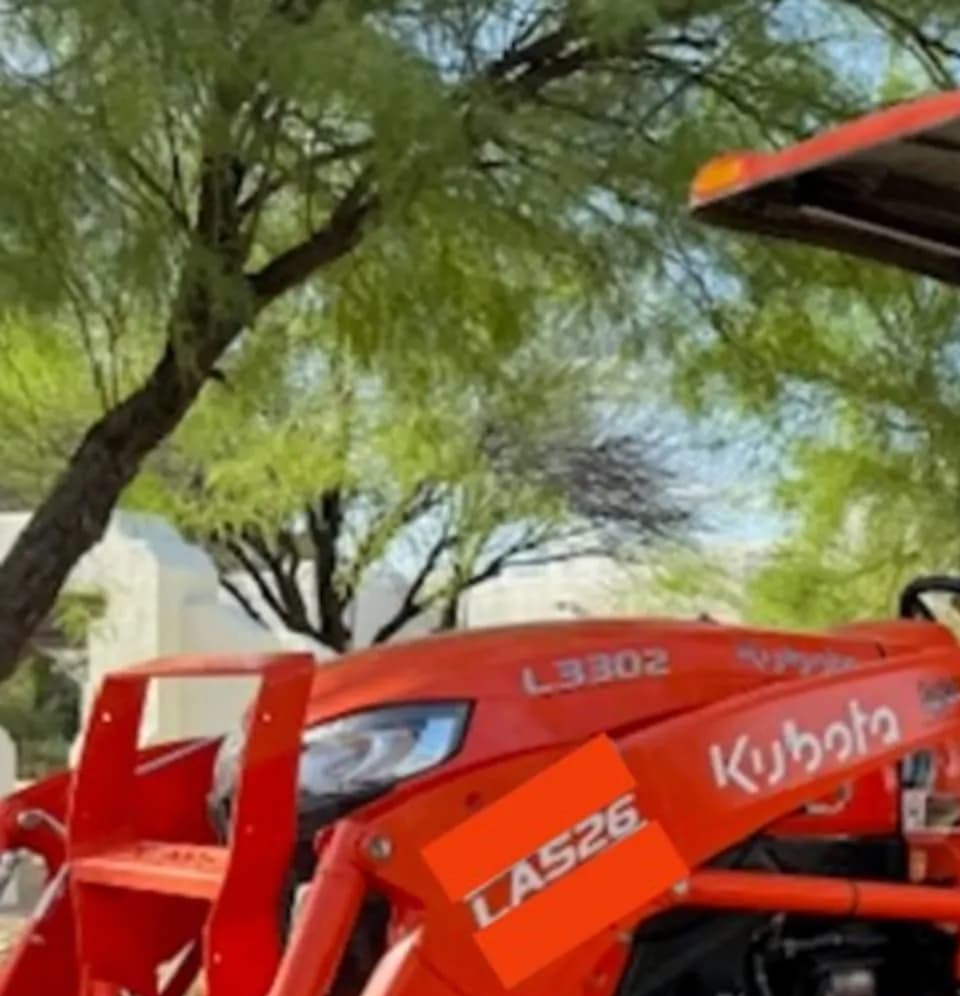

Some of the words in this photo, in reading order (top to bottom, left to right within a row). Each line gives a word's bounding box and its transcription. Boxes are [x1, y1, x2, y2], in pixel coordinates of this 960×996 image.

[521, 648, 670, 695] L3302
[710, 700, 899, 793] Kubota
[472, 793, 640, 929] LA526
